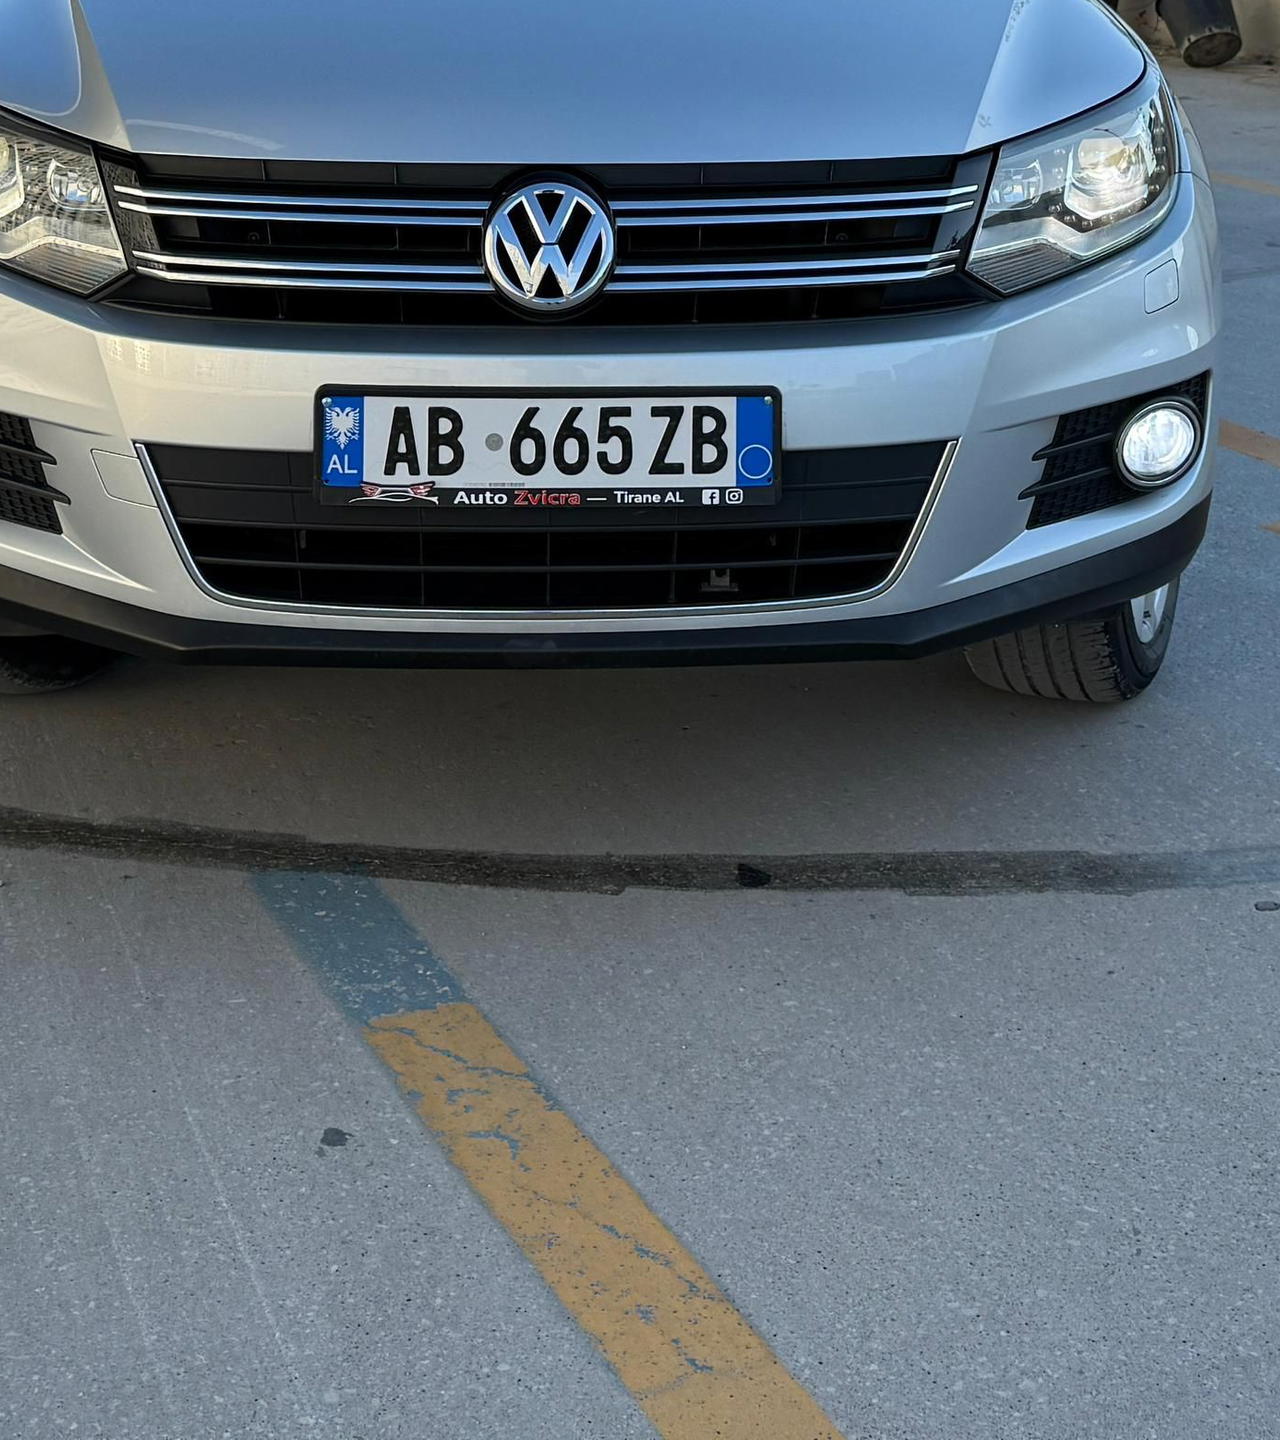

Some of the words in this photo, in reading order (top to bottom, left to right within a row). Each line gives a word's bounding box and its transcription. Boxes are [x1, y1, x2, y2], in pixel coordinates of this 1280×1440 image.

[383, 406, 465, 476] AB
[509, 406, 633, 476] 665
[648, 405, 729, 475] ZB
[326, 453, 358, 474] AL
[453, 490, 508, 505] Auto
[513, 489, 581, 505] Zvicra
[613, 490, 664, 504] Tirane
[664, 491, 685, 504] AL
